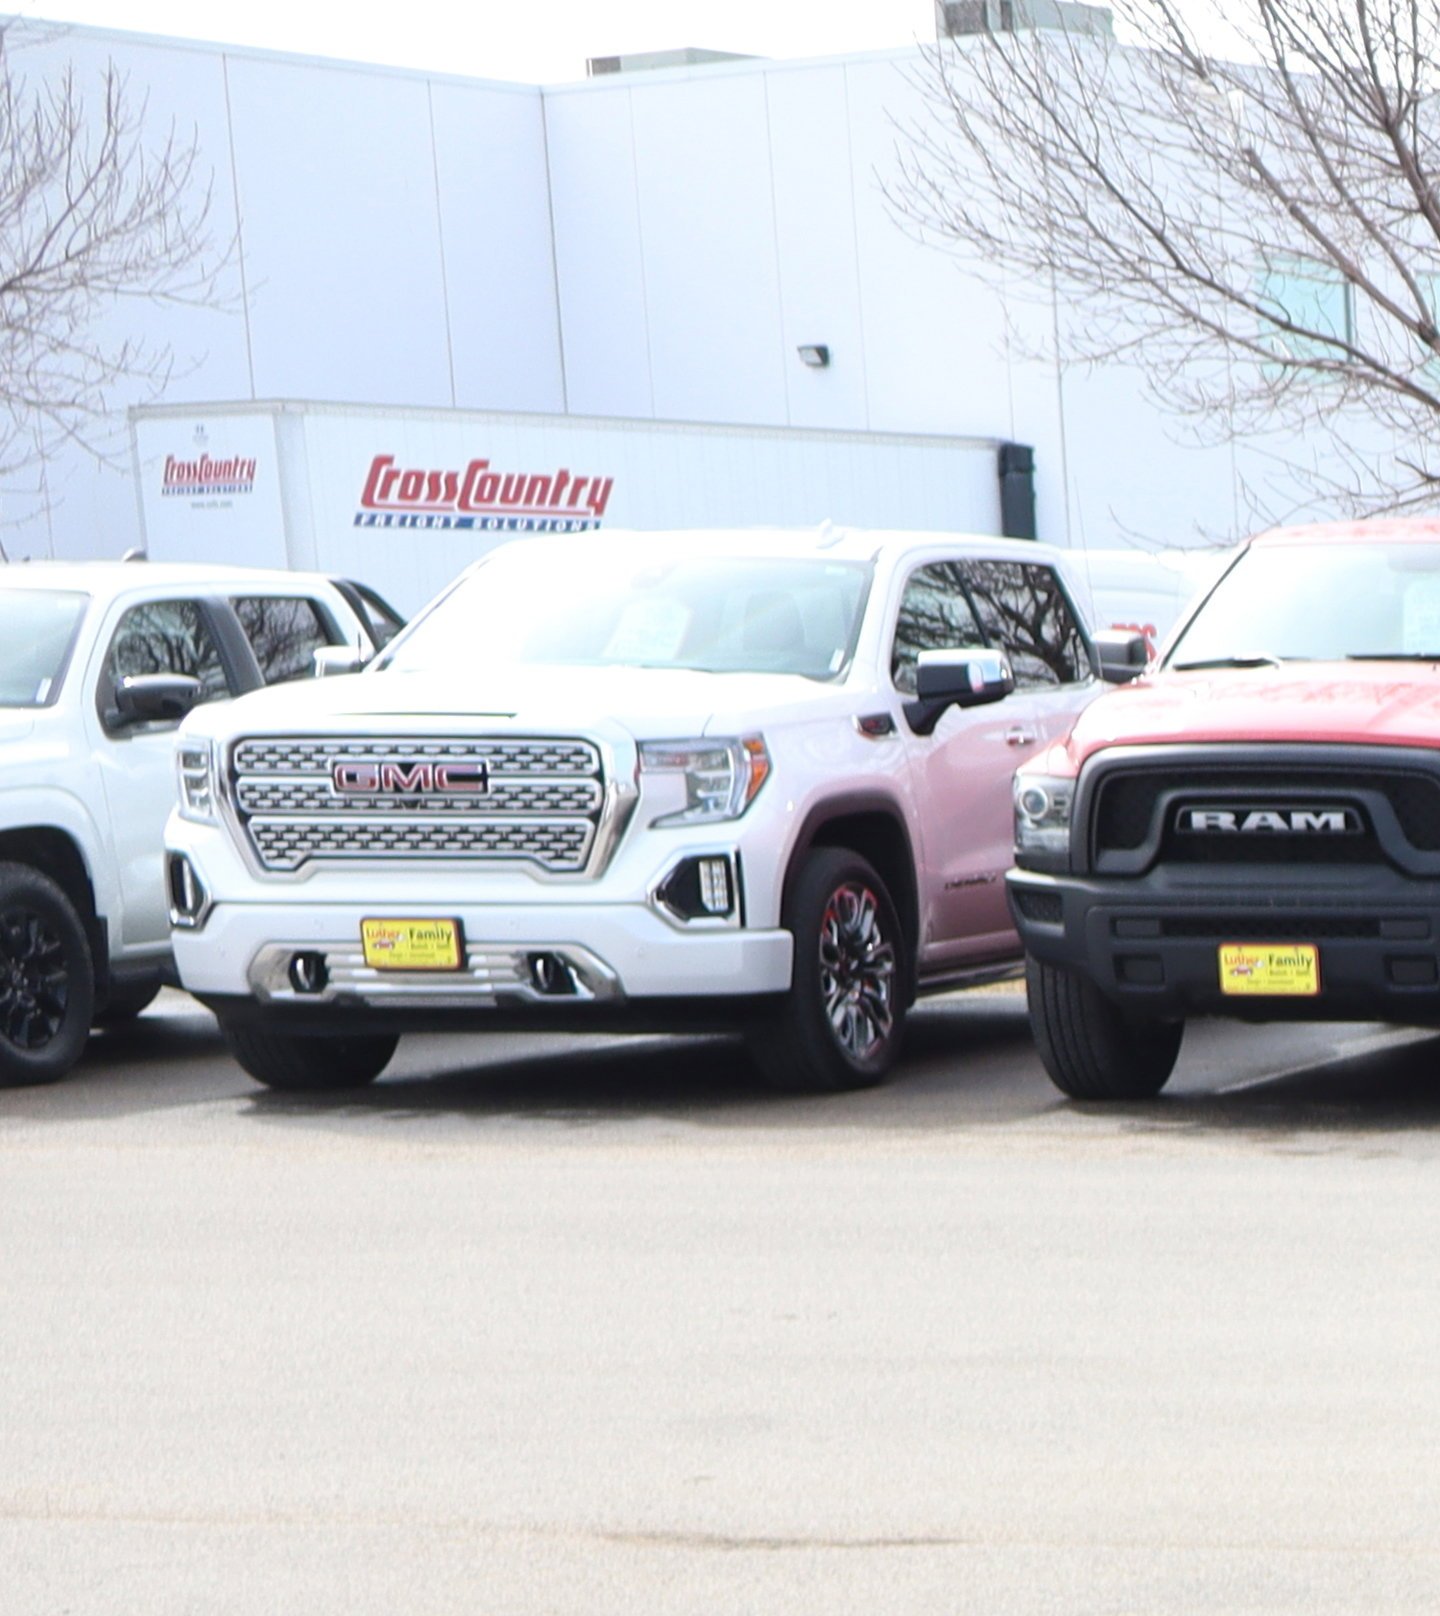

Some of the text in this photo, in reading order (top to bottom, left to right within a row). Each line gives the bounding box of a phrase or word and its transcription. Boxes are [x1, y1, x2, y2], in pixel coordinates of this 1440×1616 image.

[360, 454, 615, 517] CrossCountry
[334, 762, 483, 793] GMC
[1190, 810, 1346, 832] RAM
